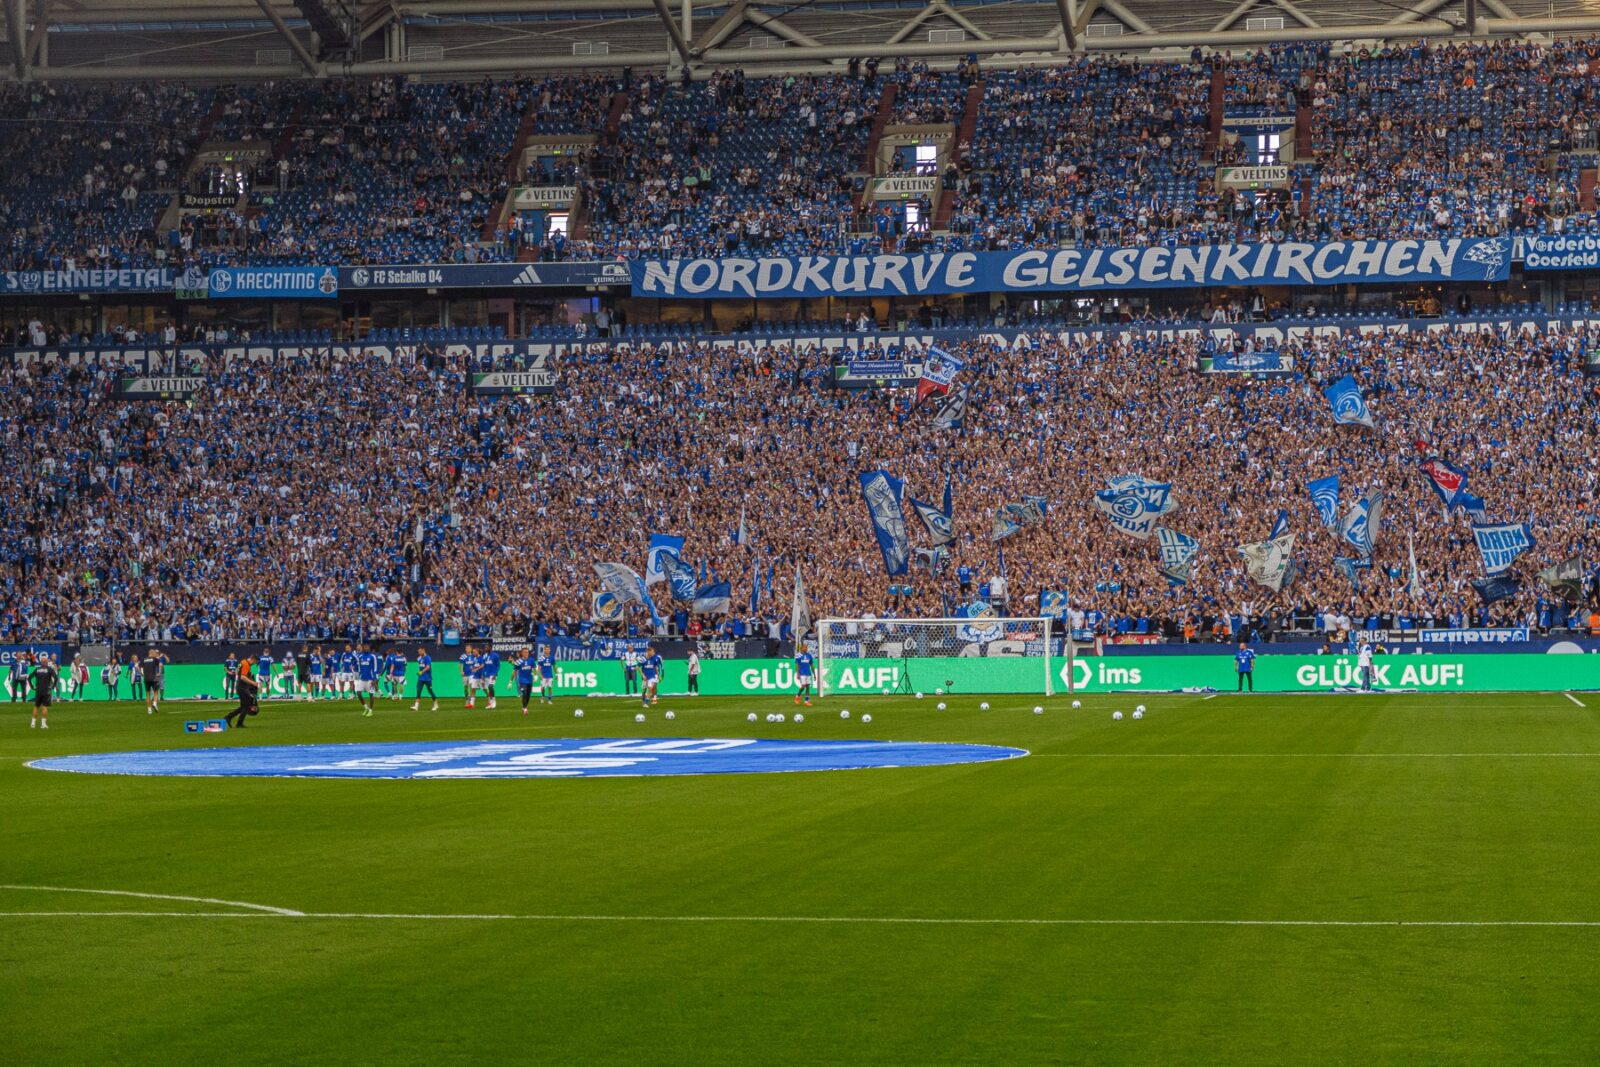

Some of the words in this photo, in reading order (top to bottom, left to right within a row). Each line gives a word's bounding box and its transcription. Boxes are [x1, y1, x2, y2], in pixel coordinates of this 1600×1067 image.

[1242, 168, 1287, 179] VELTINS
[893, 179, 936, 191] VELTINS
[533, 189, 576, 200] VELTINS
[1526, 251, 1598, 267] Coesfeld
[641, 252, 978, 297] NORDKURVE
[1003, 238, 1463, 285] GELSENKIRCHEN
[236, 272, 315, 290] KRECHTING
[373, 270, 386, 284] FC
[387, 270, 427, 284] Schalke
[428, 269, 443, 283] 04
[151, 379, 201, 392] VELTINS
[502, 374, 552, 386] VELTINS
[556, 667, 597, 688] ims
[839, 667, 899, 689] AUF!
[1098, 663, 1142, 684] ims
[1400, 663, 1464, 686] AUF!
